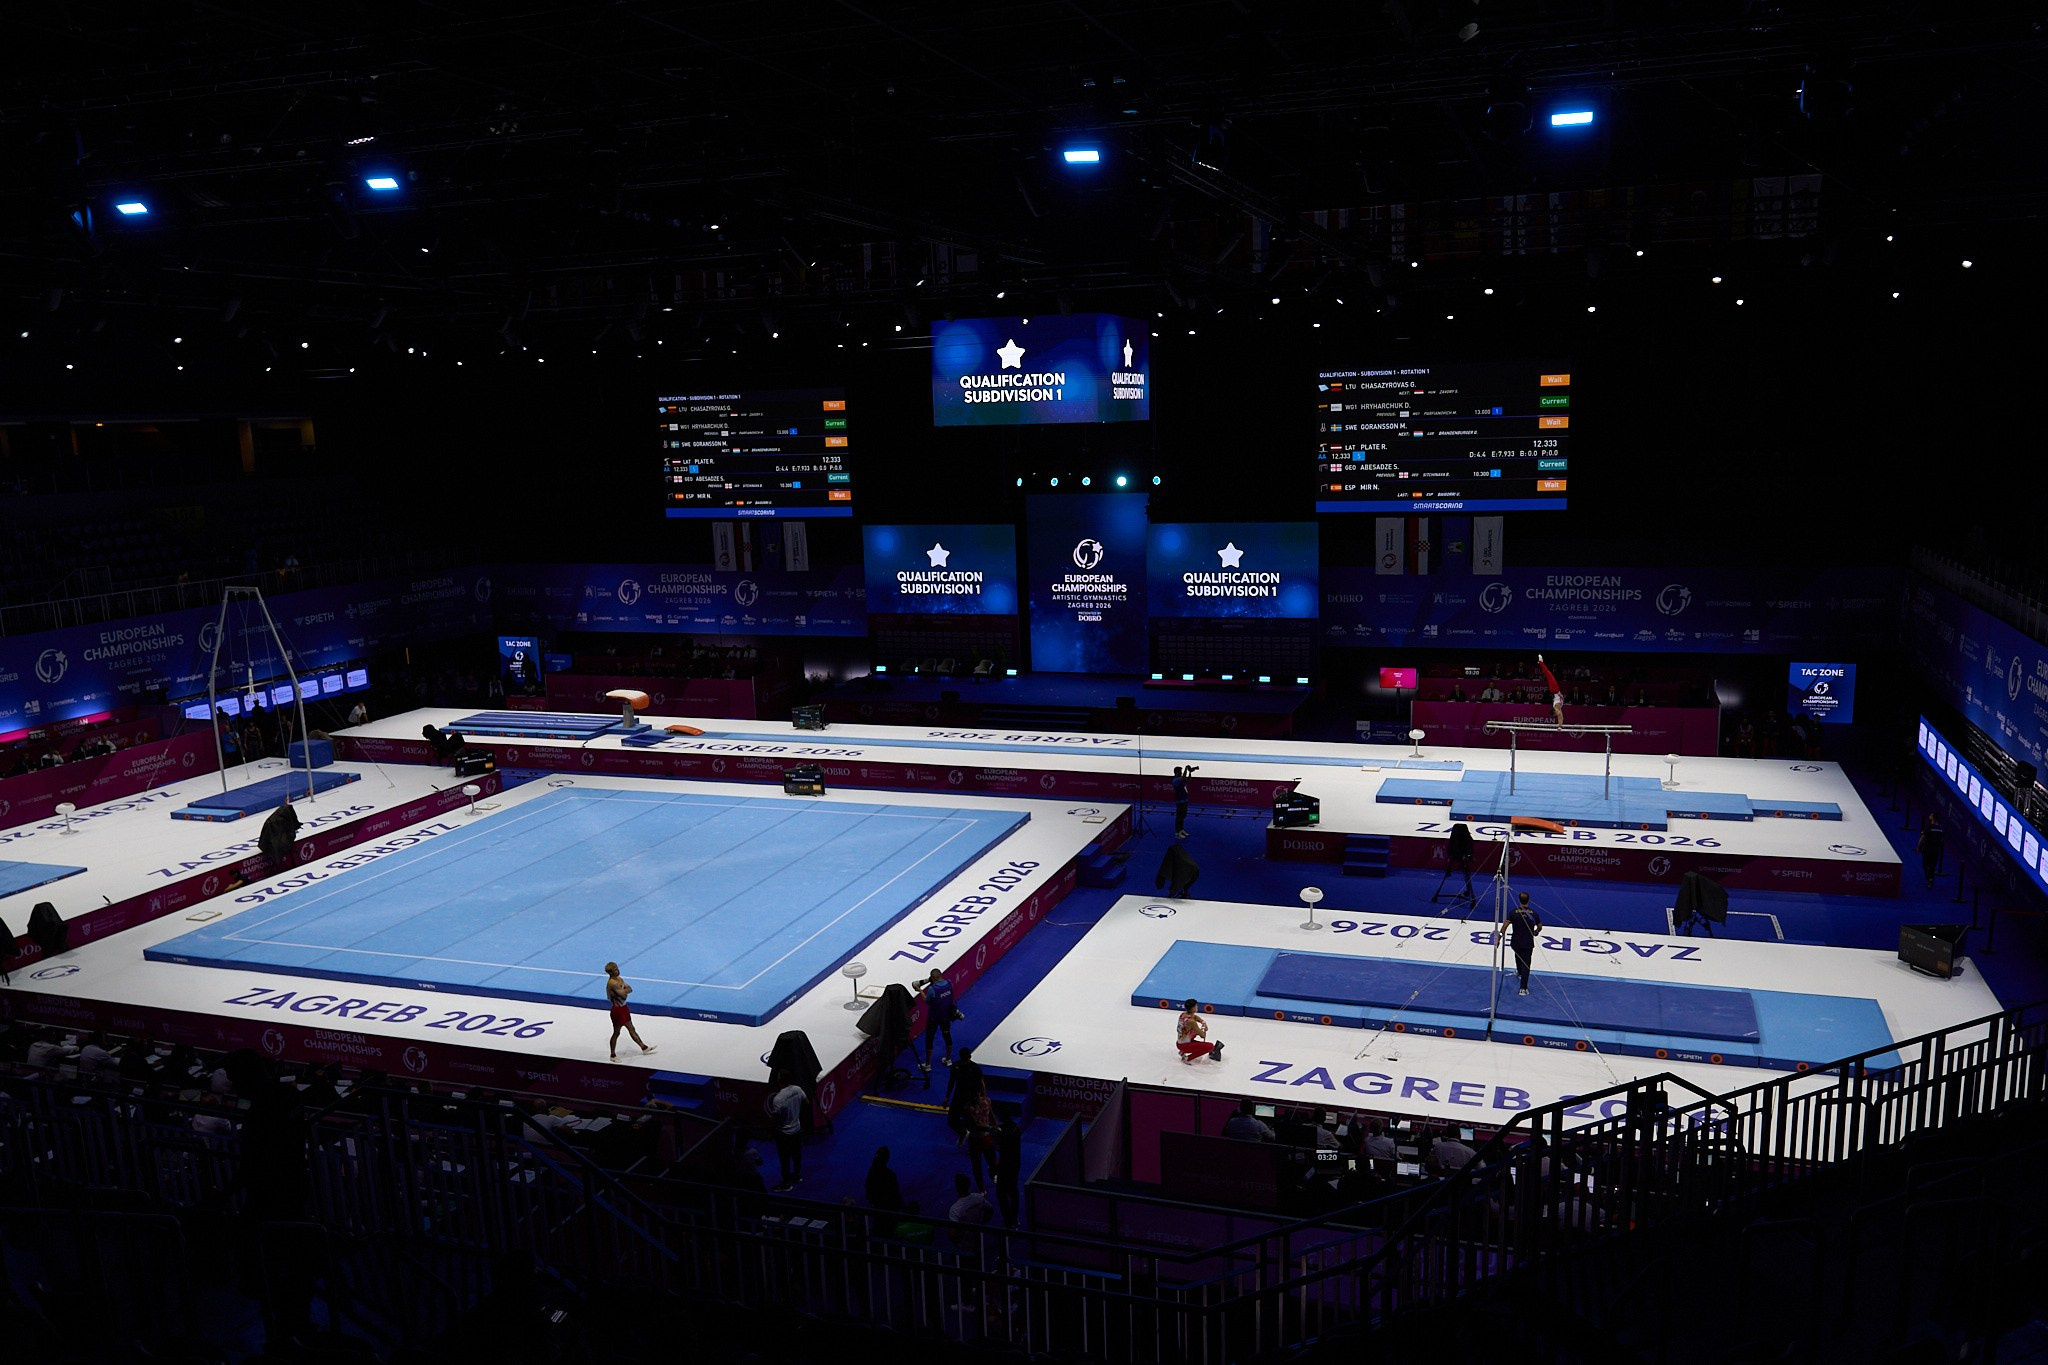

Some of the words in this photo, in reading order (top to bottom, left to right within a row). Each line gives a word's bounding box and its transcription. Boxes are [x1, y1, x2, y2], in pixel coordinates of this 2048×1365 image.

[960, 372, 1065, 388] QUALIFICATION
[1112, 372, 1144, 385] QUALIFICATION
[964, 389, 1050, 403] SUBDIVISION
[1056, 389, 1062, 400] 1
[1113, 387, 1139, 399] SUBDIVISION
[661, 574, 712, 583] EUROPEAN
[897, 571, 982, 583] QUALIFICATION
[1065, 574, 1113, 583] EUROPEAN
[1183, 572, 1280, 585] QUALIFICATION
[1546, 575, 1621, 587] EUROPEAN
[648, 585, 727, 595] CHAMPIONSHIPS
[901, 584, 973, 594] SUBDIVISION
[976, 584, 980, 594] 1
[1052, 583, 1127, 593] CHAMPIONSHIPS
[1186, 586, 1268, 597] SUBDIVISION
[1272, 587, 1276, 596] 1
[1526, 588, 1642, 600] CHAMPIONSHIPS
[1328, 594, 1363, 603] DOBRO
[1550, 604, 1589, 612] ZAGREB
[1593, 604, 1616, 612] 2026
[305, 612, 334, 626] SPIETH
[100, 624, 165, 644] EUROPEAN
[84, 634, 184, 661] CHAMPIONSHIPS
[109, 658, 142, 670] ZAGREB
[147, 654, 166, 664] 2026
[928, 731, 993, 740] 2026
[1004, 735, 1132, 745] ZAGREB
[669, 742, 788, 753] ZAGREB
[793, 748, 865, 757] 2026
[132, 754, 167, 768] EUROPEAN
[736, 762, 783, 770] CHAMPIONSHIPS
[124, 758, 176, 777] CHAMPIONSHIPS
[823, 768, 850, 776] DOBRO
[984, 768, 1018, 776] EUROPEAN
[975, 774, 1027, 783] CHAMPIONSHIPS
[1211, 779, 1248, 787] EUROPEAN
[1201, 785, 1258, 794] CHAMPIONSHIPS
[303, 805, 374, 828] 2026
[371, 820, 390, 832] SPIETH
[326, 823, 461, 869] ZAGREB
[1283, 839, 1324, 851] DOBRO
[1615, 833, 1721, 848] 2026
[1561, 848, 1608, 857] EUROPEAN
[1547, 855, 1621, 865] CHAMPIONSHIPS
[1781, 870, 1812, 878] SPIETH
[234, 872, 329, 903] 2026
[889, 895, 997, 964] ZAGREB
[978, 861, 1039, 892] 2026
[1331, 920, 1450, 941] 2026
[224, 987, 428, 1023] ZAGREB
[425, 1011, 553, 1038] 2026
[316, 1030, 366, 1044] EUROPEAN
[304, 1038, 383, 1057] CHAMPIONSHIPS
[528, 1071, 558, 1083] SPIETH
[1053, 1076, 1118, 1092] EUROPEAN
[1250, 1060, 1531, 1110] ZAGREB
[1318, 1153, 1337, 1161] 03:20
